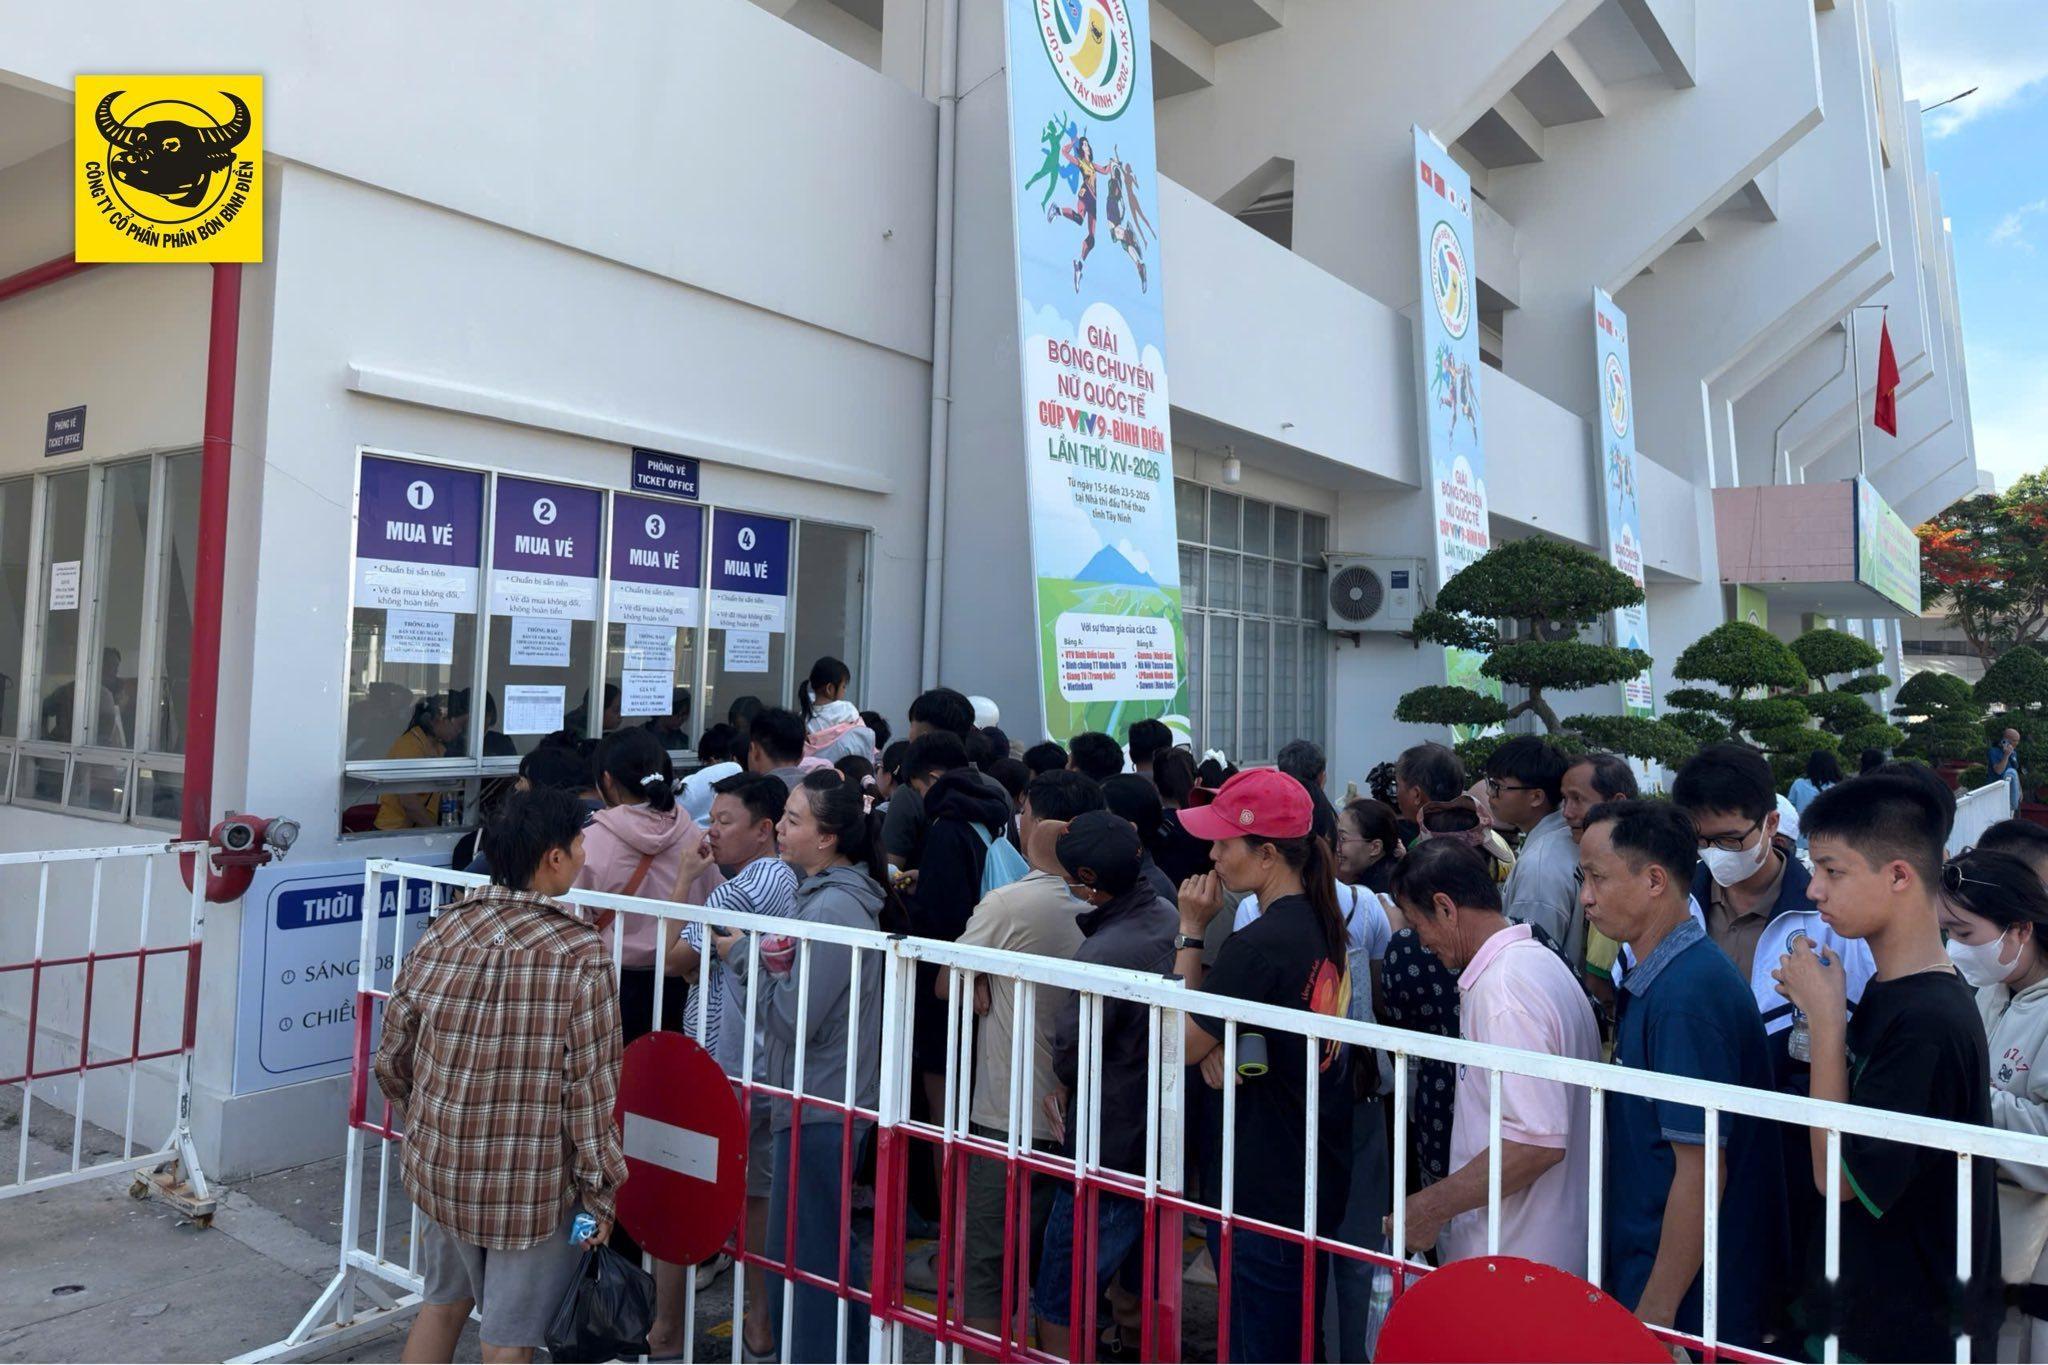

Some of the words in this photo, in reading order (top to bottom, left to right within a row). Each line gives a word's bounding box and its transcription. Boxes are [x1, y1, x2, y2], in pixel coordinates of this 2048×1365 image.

[1073, 76, 1090, 101] TÂY
[1090, 92, 1114, 109] NINH
[1088, 325, 1118, 355] GIẢI
[1048, 339, 1095, 374] BÓNG
[1058, 373, 1080, 400] NỮ
[1083, 381, 1127, 413] QUỐC
[1128, 392, 1146, 419] TẾ
[1039, 399, 1065, 429] CÚP
[1049, 433, 1079, 465] LẦN
[1080, 443, 1108, 470] THỨ
[647, 460, 674, 474] PHÒNG
[676, 464, 687, 476] VÉ
[637, 473, 666, 487] TICKET
[668, 479, 695, 492] OFFICE
[1077, 481, 1093, 492] ngày
[1094, 482, 1108, 493] 15-5
[414, 485, 424, 506] 1
[539, 502, 551, 521] 2
[386, 520, 427, 543] MUA
[432, 523, 454, 546] VÉ
[650, 518, 660, 536] 3
[515, 534, 551, 556] MUA
[555, 537, 574, 558] VÉ
[742, 531, 751, 547] 4
[629, 548, 660, 568] MUA
[664, 550, 680, 570] VÉ
[379, 564, 404, 574] Chuẩn
[406, 565, 414, 576] bị
[416, 567, 429, 577] sẵn
[430, 568, 446, 577] tiền
[724, 559, 751, 577] MUA
[754, 560, 768, 579] VÉ
[510, 575, 533, 585] Chuẩn
[534, 577, 541, 586] bị
[377, 596, 402, 607] không
[403, 597, 422, 607] hoàn
[424, 598, 439, 608] tiền
[378, 586, 390, 594] Vé
[391, 586, 401, 595] đã
[421, 588, 444, 600] không
[510, 595, 520, 603] Vé
[521, 595, 530, 603] đã
[547, 597, 567, 607] không
[509, 604, 530, 615] không
[531, 605, 548, 614] hoàn
[1100, 623, 1115, 632] tham
[1116, 624, 1125, 635] gia
[303, 890, 354, 922] THỜI
